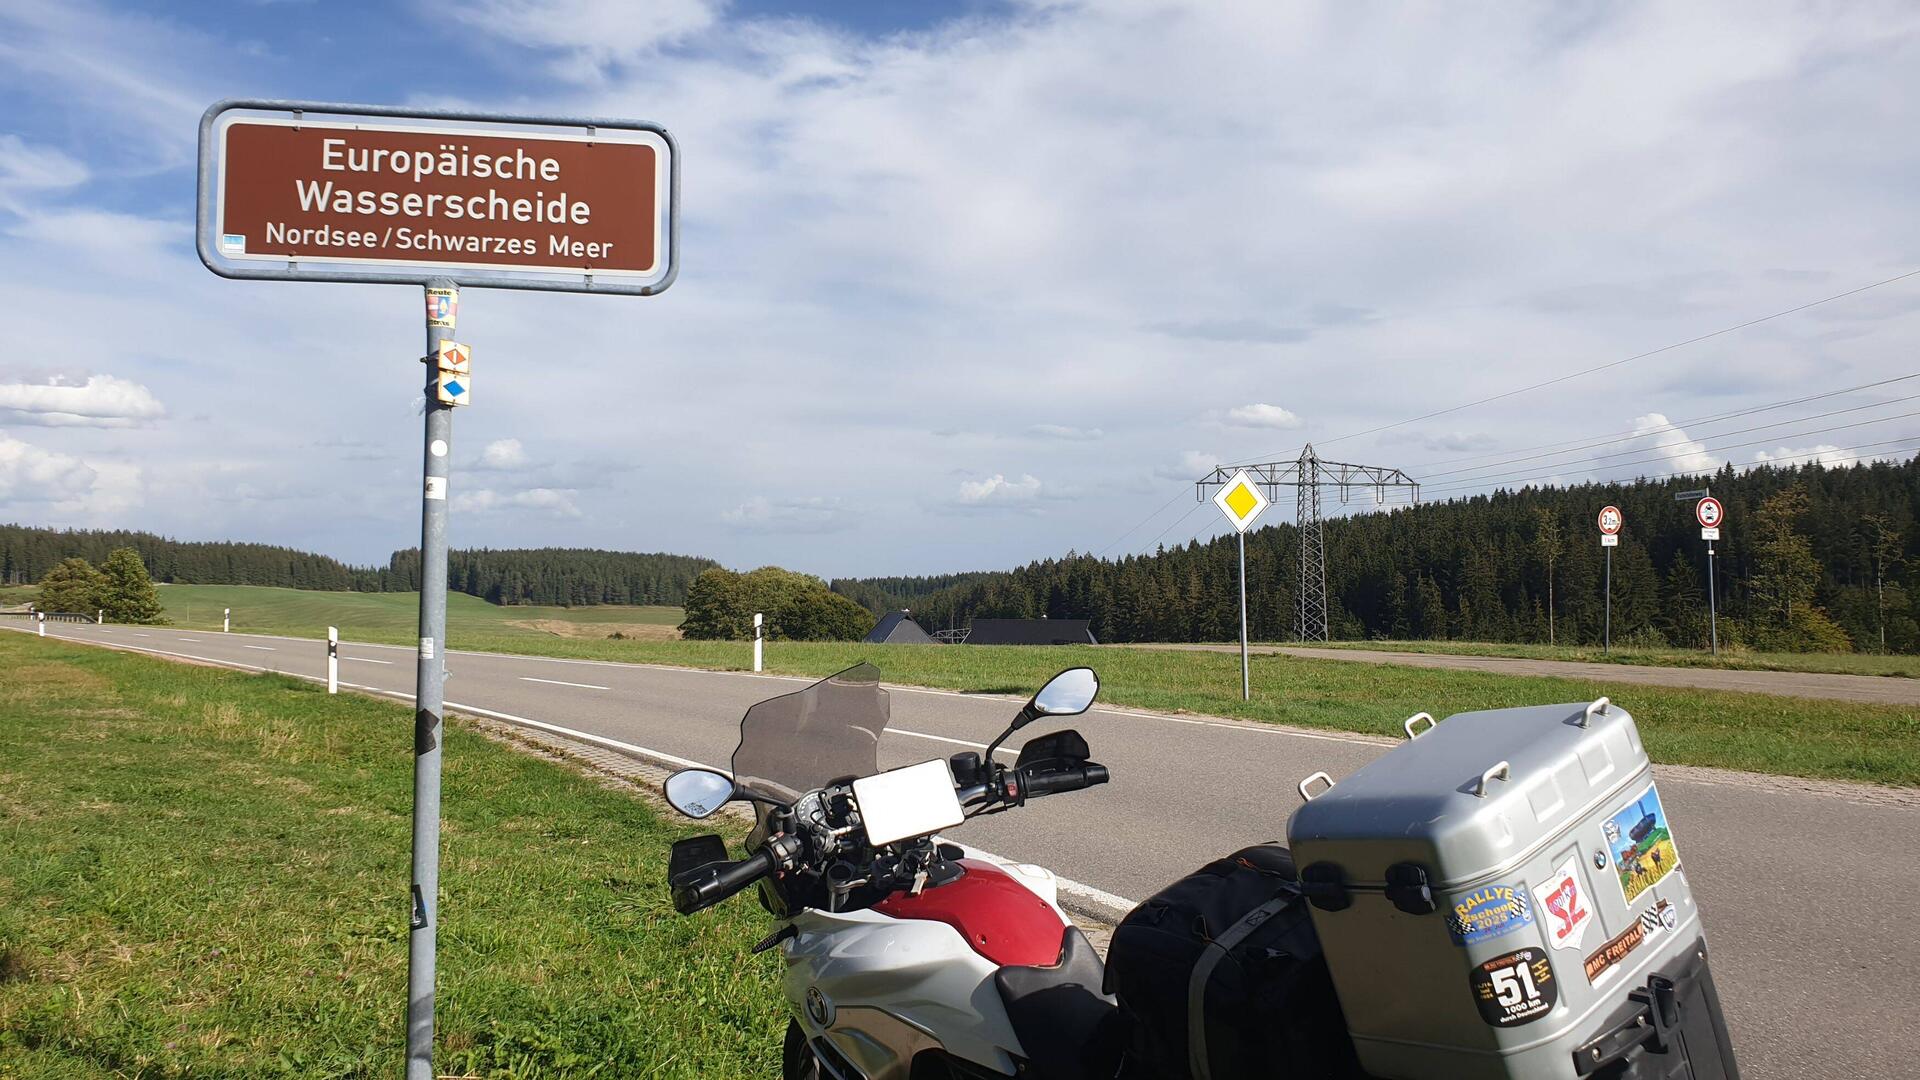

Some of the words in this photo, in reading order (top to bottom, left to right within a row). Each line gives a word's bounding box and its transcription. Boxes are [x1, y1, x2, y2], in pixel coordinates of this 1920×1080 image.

[323, 139, 559, 182] Europäische
[296, 180, 590, 224] Wasserscheide
[550, 235, 613, 258] Meer
[1455, 887, 1514, 918] RALLYE
